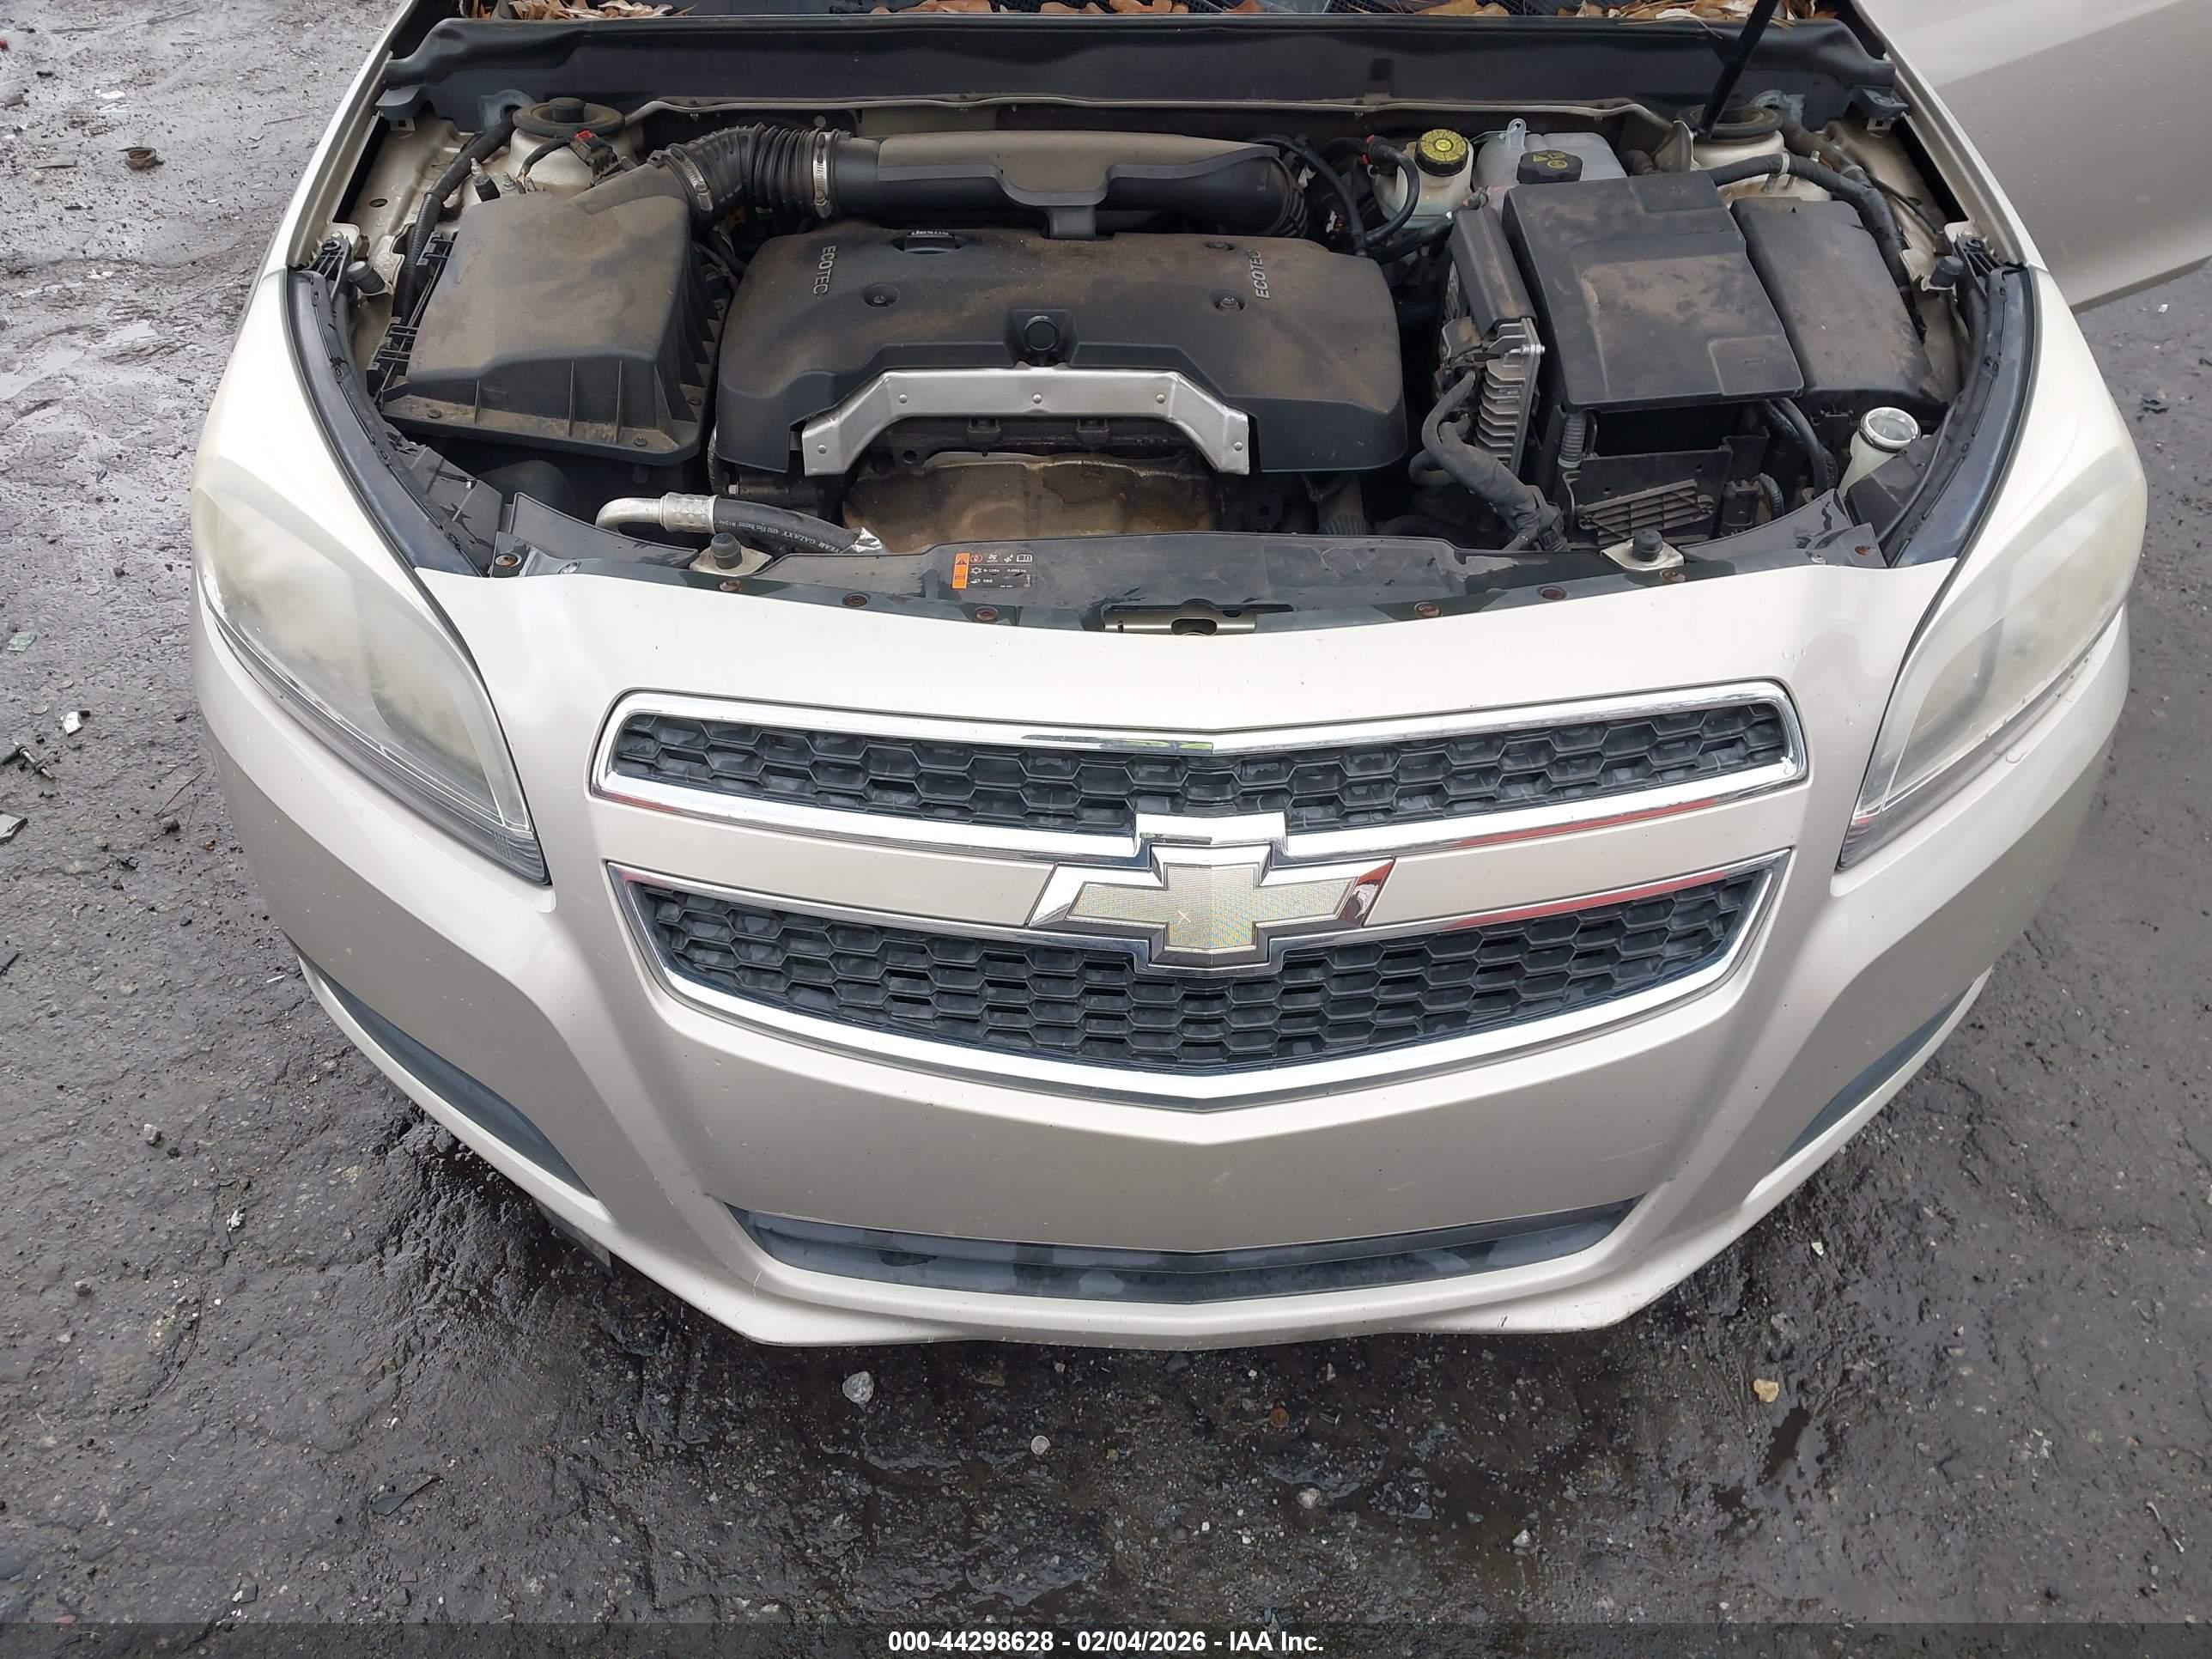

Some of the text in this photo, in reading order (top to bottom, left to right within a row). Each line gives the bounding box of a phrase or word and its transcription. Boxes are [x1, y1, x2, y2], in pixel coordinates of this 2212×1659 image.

[813, 246, 836, 295] ECOTEC
[1249, 250, 1270, 299] ECOTEC
[782, 531, 816, 544] GALAXY
